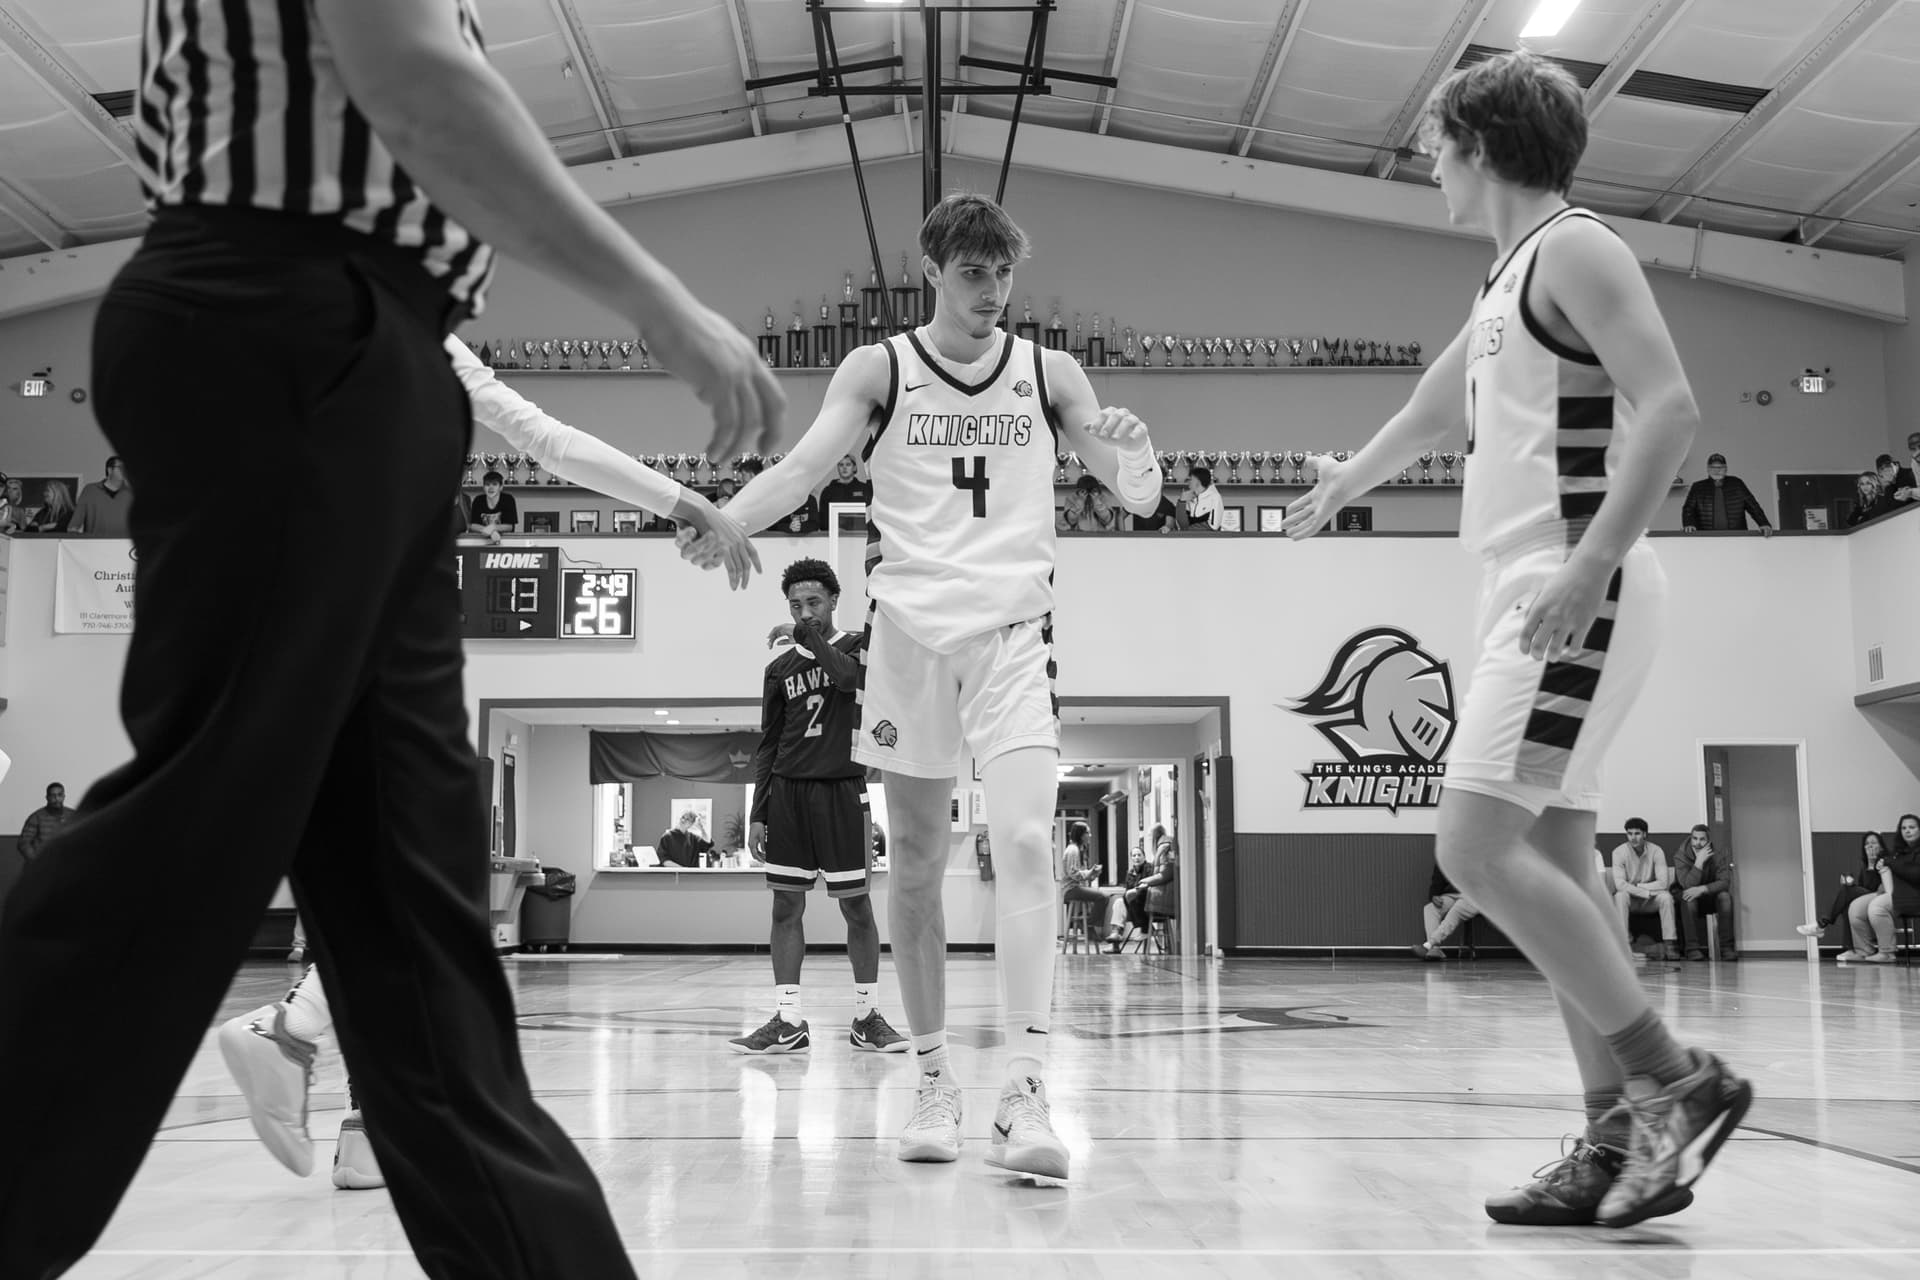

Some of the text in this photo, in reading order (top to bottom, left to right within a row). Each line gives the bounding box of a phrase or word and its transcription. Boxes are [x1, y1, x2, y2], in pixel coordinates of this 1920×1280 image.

[24, 380, 45, 396] EXIT
[1803, 376, 1823, 393] EXIT
[907, 414, 1032, 446] KNIGHTS
[951, 456, 990, 518] 4
[485, 553, 543, 568] HOME
[511, 577, 538, 612] 13
[582, 574, 628, 596] 2:49
[574, 597, 621, 634] 26
[804, 694, 824, 737] 2
[1317, 764, 1444, 773] THE KING'S ACADE
[1307, 776, 1443, 807] KNIGHT
